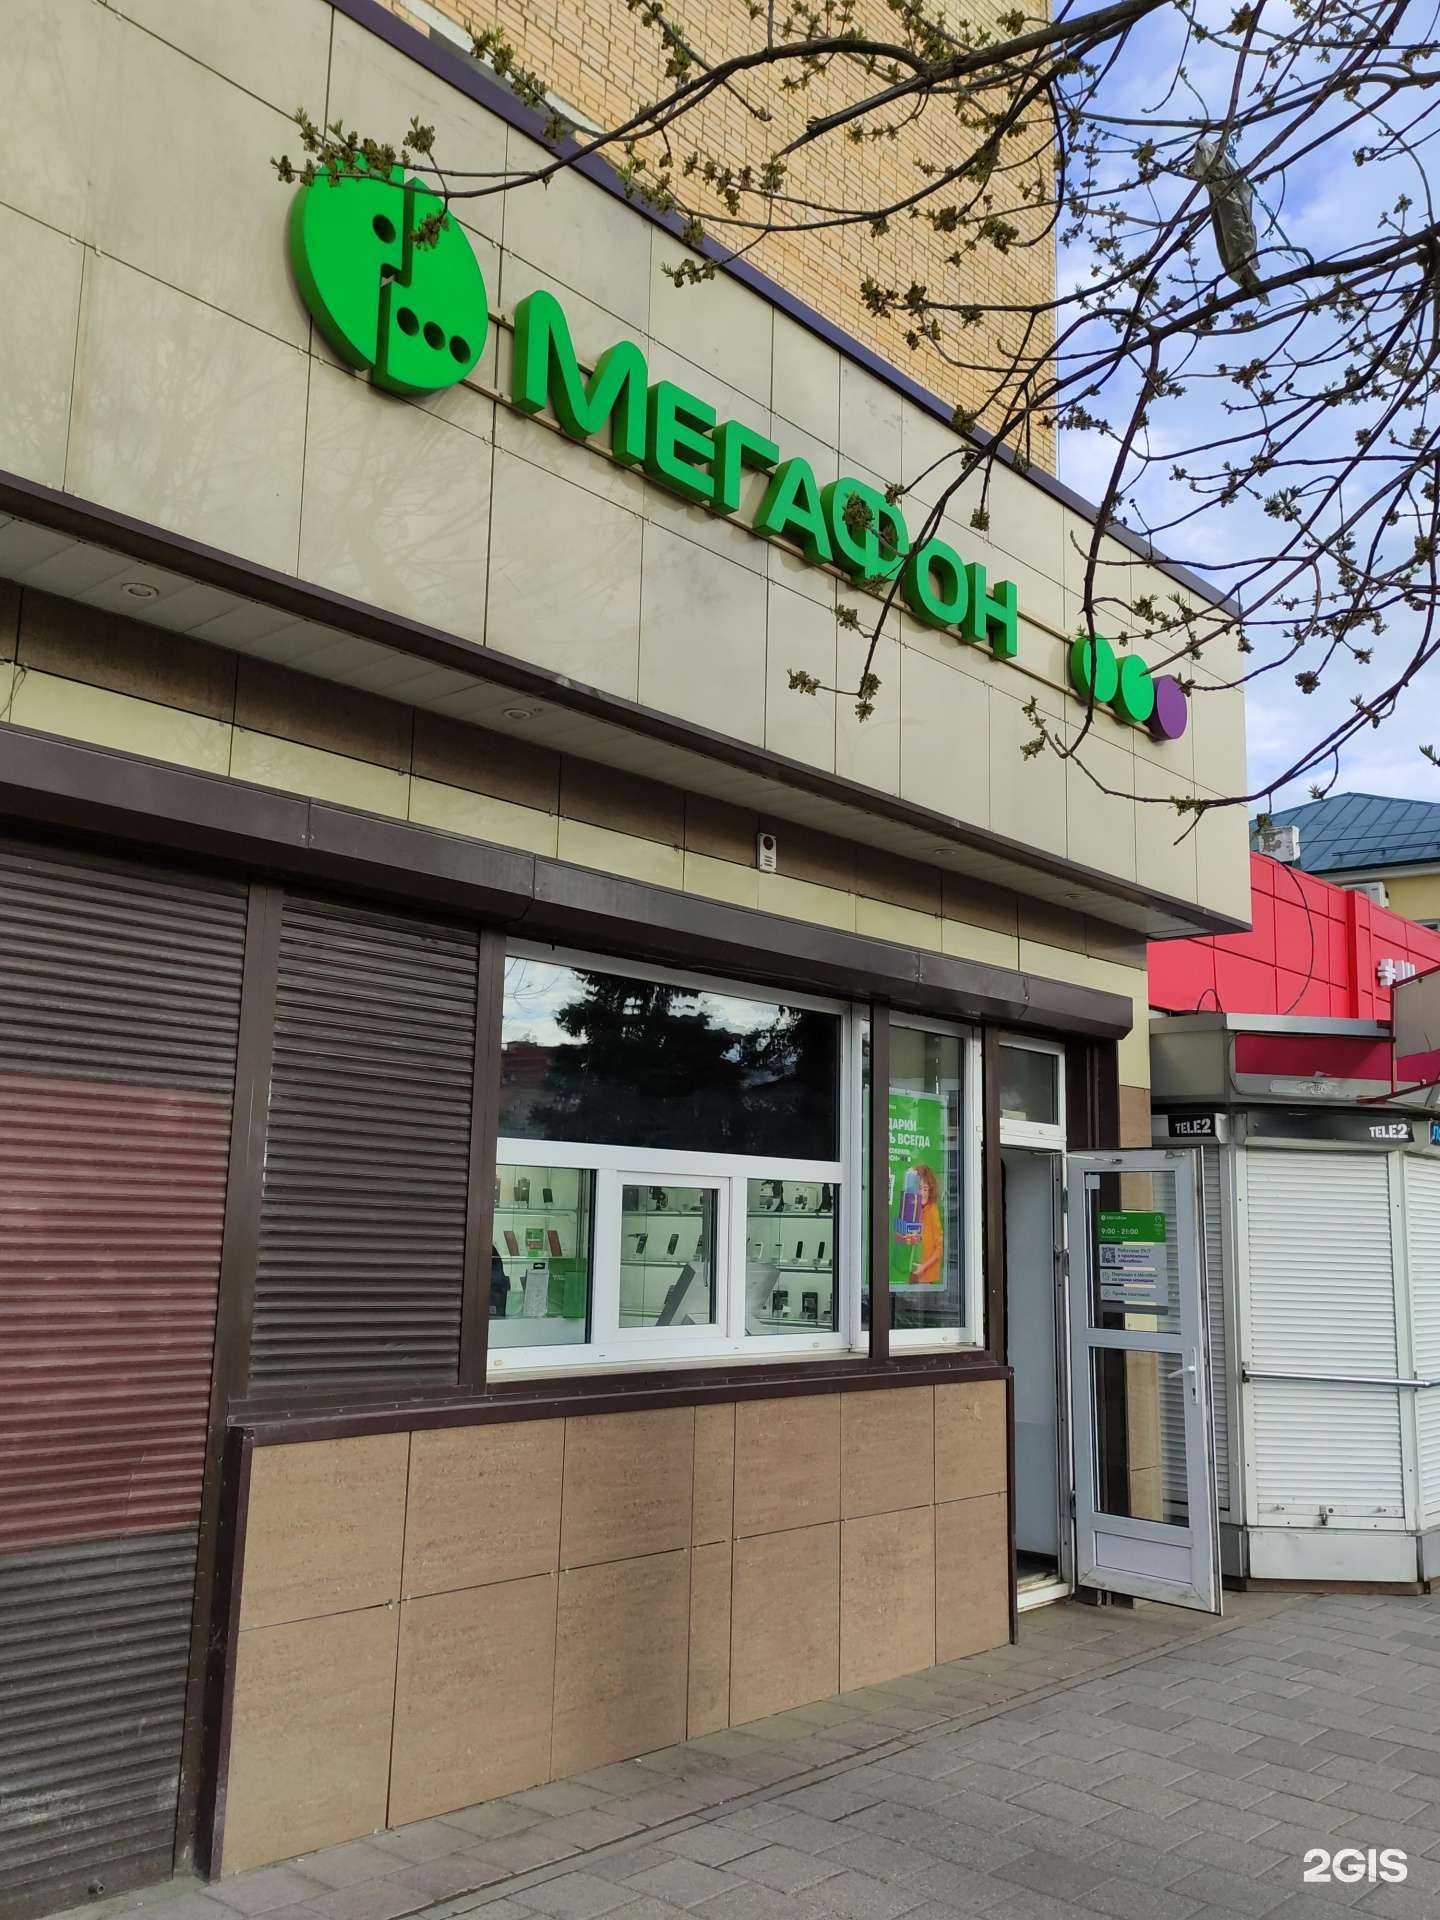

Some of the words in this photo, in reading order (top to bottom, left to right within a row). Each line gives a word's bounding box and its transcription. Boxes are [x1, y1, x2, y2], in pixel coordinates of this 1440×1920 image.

[1175, 1118, 1212, 1134] TELE2
[1369, 1123, 1409, 1139] TELE2
[897, 1133, 930, 1149] ВСЕГДА
